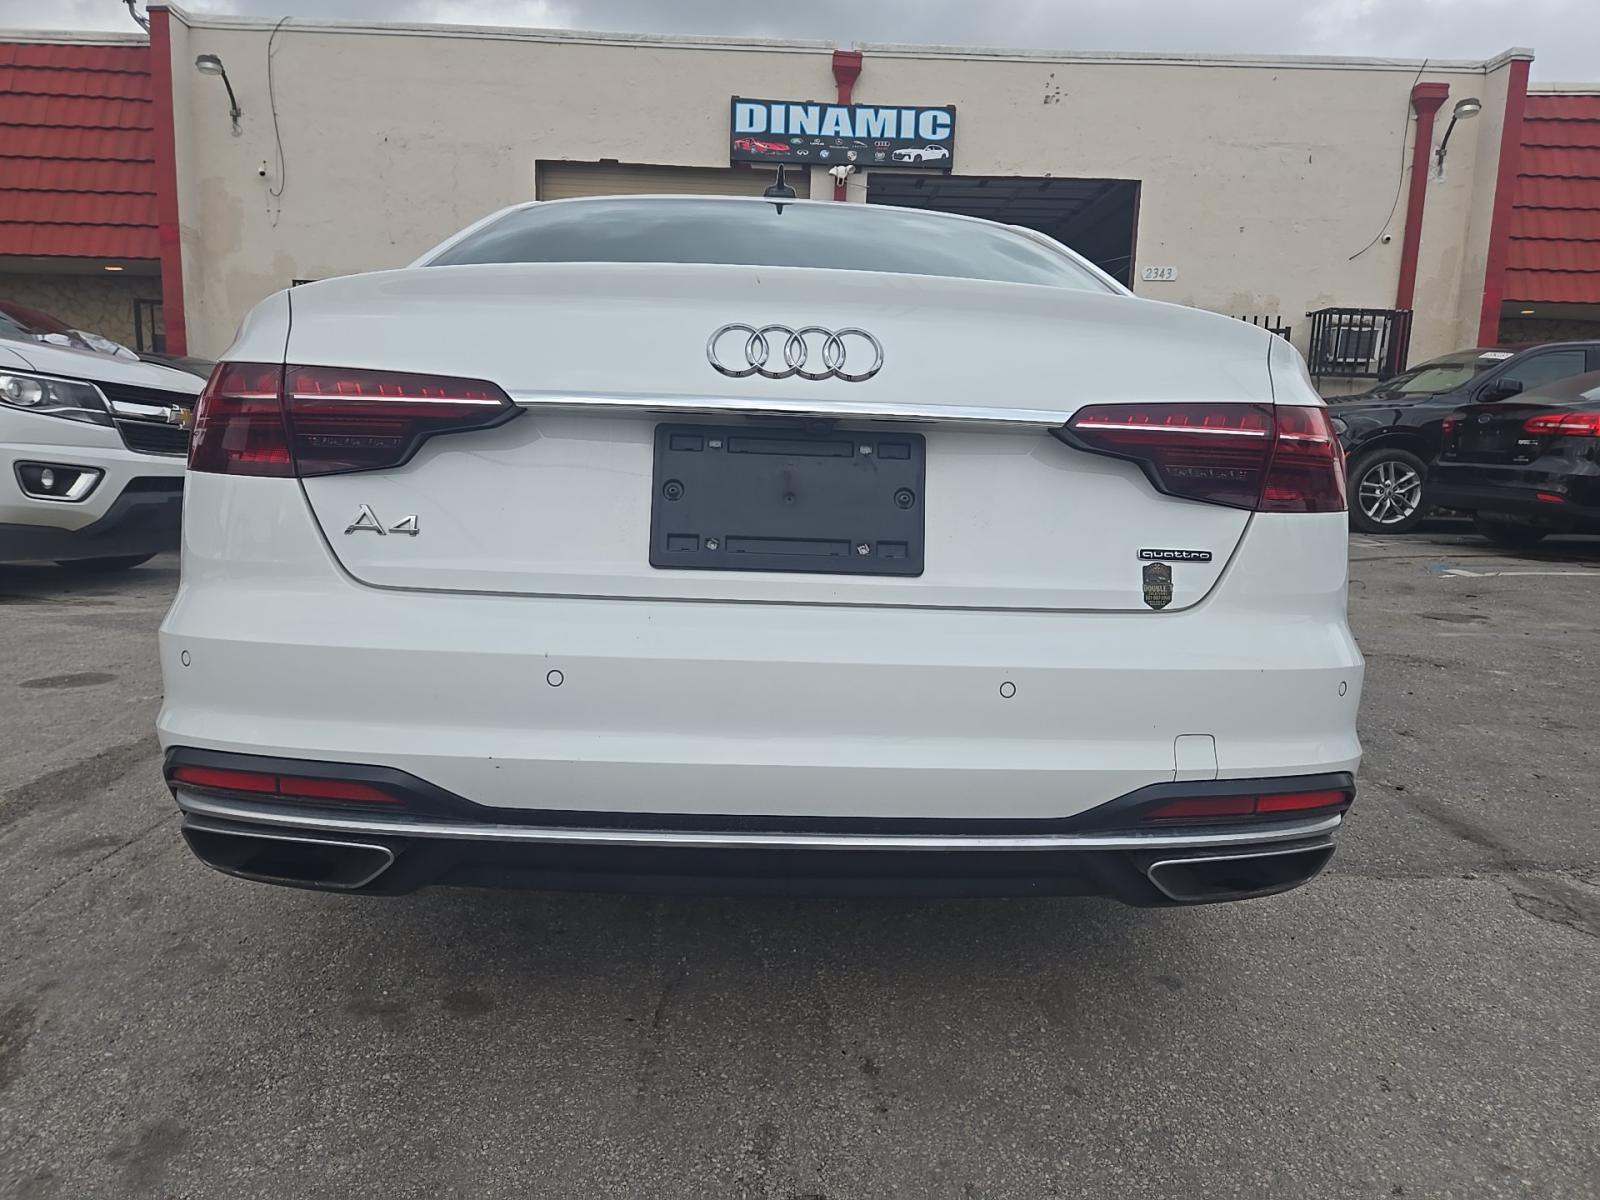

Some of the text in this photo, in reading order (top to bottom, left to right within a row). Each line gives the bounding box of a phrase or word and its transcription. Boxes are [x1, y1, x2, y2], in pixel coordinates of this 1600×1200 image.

[735, 102, 951, 140] DINAMIC
[1144, 267, 1173, 279] 2343
[344, 504, 420, 537] A4
[1142, 551, 1210, 559] quattro
